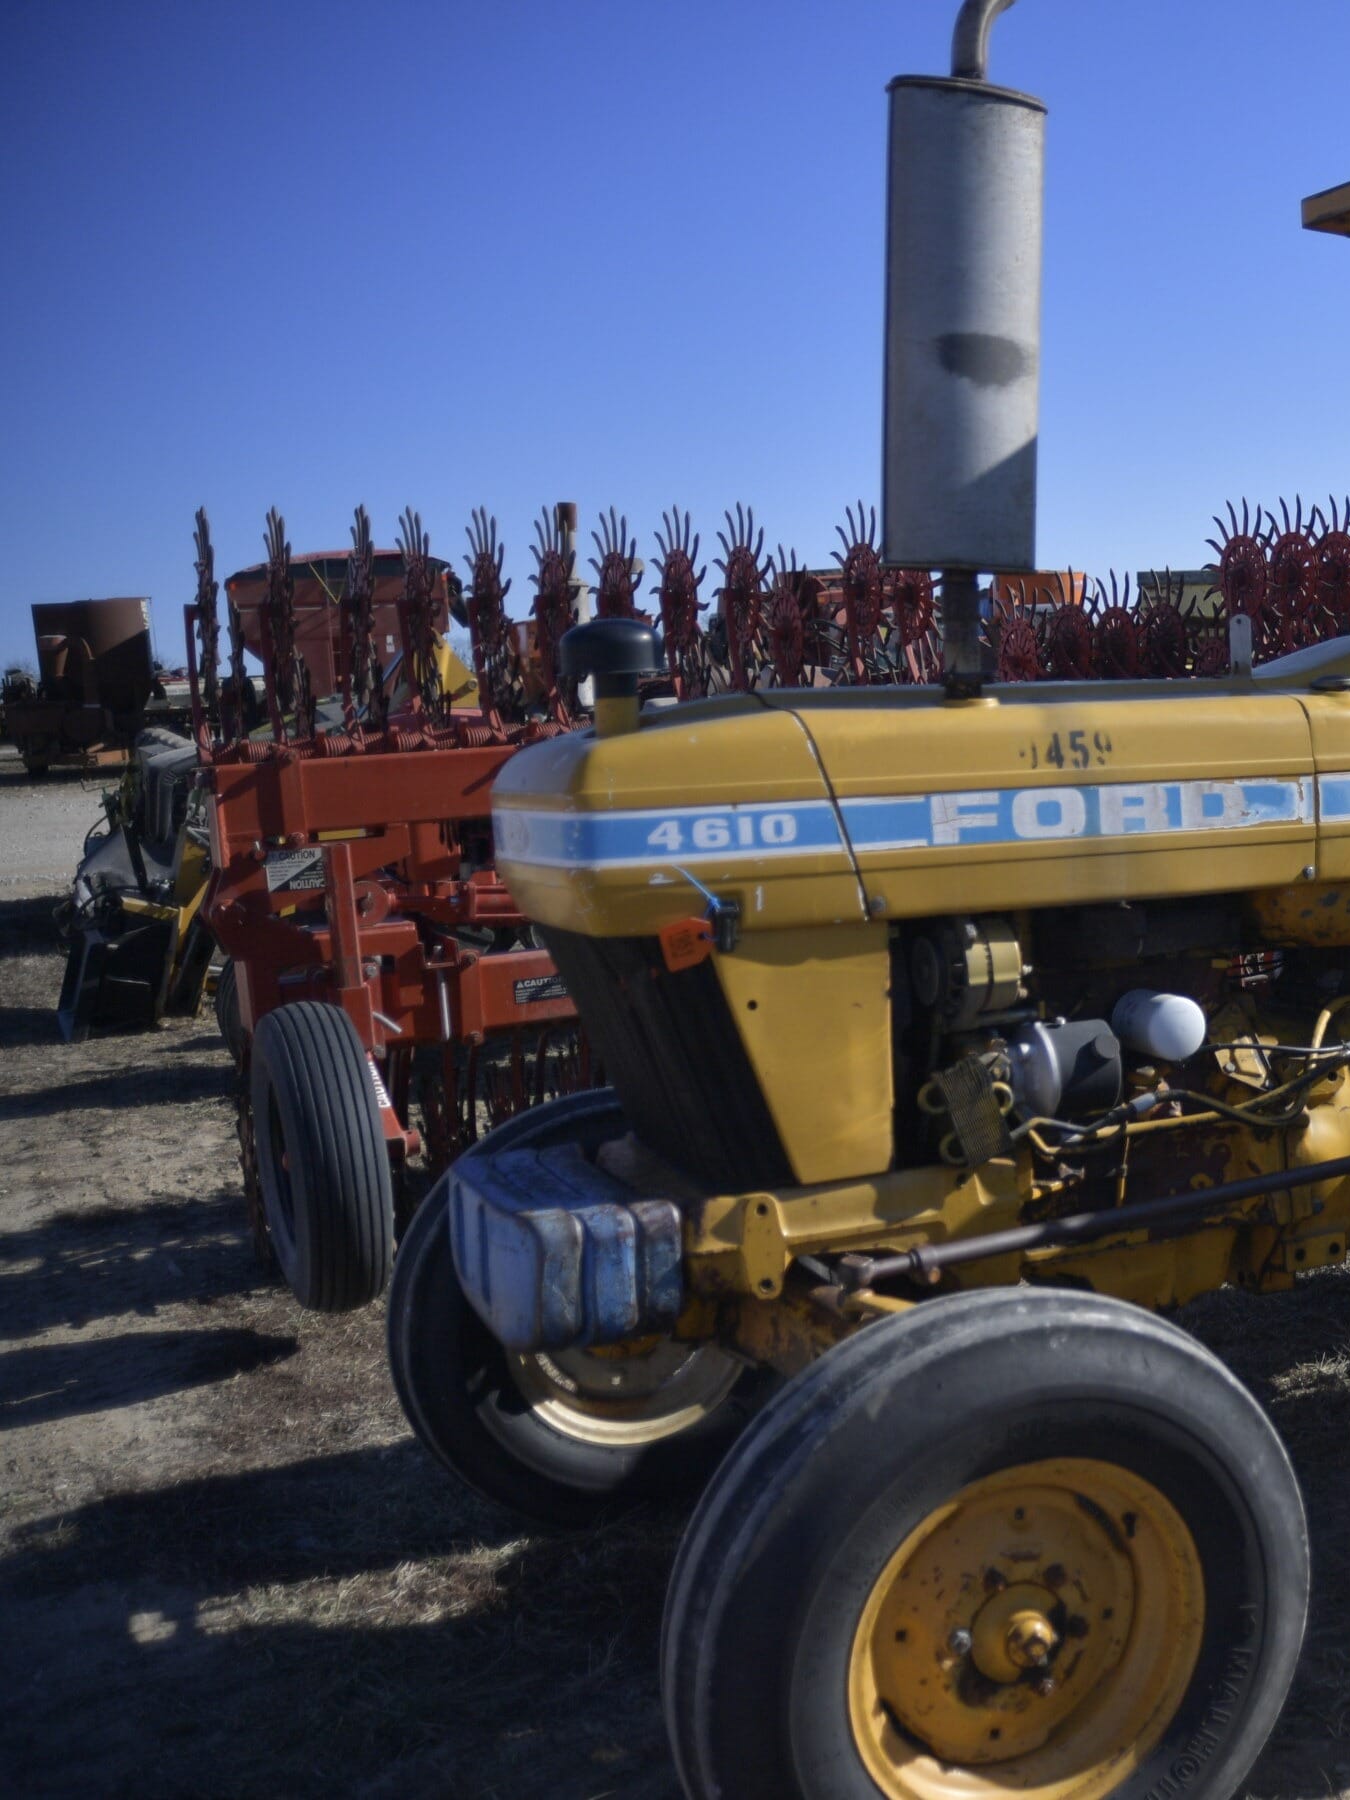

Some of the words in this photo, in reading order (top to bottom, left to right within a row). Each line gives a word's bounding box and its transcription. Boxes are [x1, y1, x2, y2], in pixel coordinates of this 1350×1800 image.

[647, 813, 798, 851] 4610
[930, 780, 1246, 846] FORD
[278, 850, 315, 861] CAUTION
